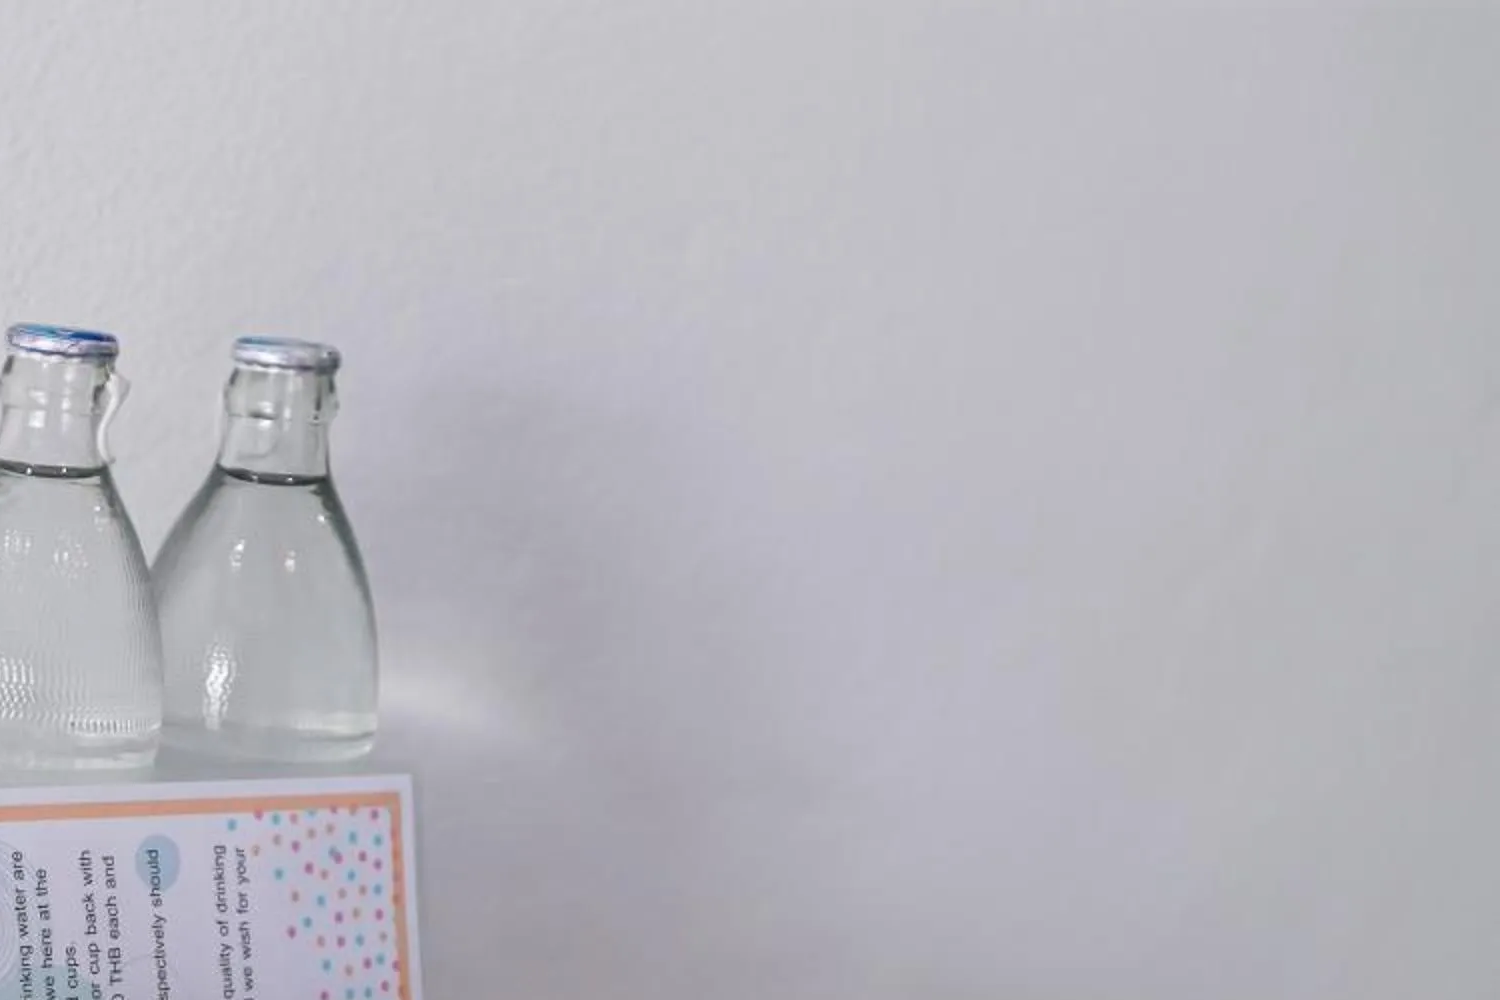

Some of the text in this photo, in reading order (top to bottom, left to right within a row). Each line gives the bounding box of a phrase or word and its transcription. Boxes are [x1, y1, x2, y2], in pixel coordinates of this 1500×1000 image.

[13, 851, 24, 880] are
[35, 869, 48, 896] the
[78, 850, 93, 886] with
[102, 855, 116, 888] and
[146, 849, 162, 907] should
[212, 844, 229, 913] drinking
[235, 847, 249, 885] your
[14, 888, 29, 937] water
[38, 904, 49, 920] at
[82, 893, 97, 935] back
[104, 896, 120, 940] each
[236, 892, 248, 914] for
[216, 919, 229, 936] of
[237, 921, 252, 960] wish
[40, 928, 53, 968] here
[88, 943, 101, 974] cup
[110, 947, 123, 986] THB
[219, 943, 236, 999] quality
[242, 967, 254, 991] we
[44, 976, 56, 1000] we
[91, 982, 101, 999] or
